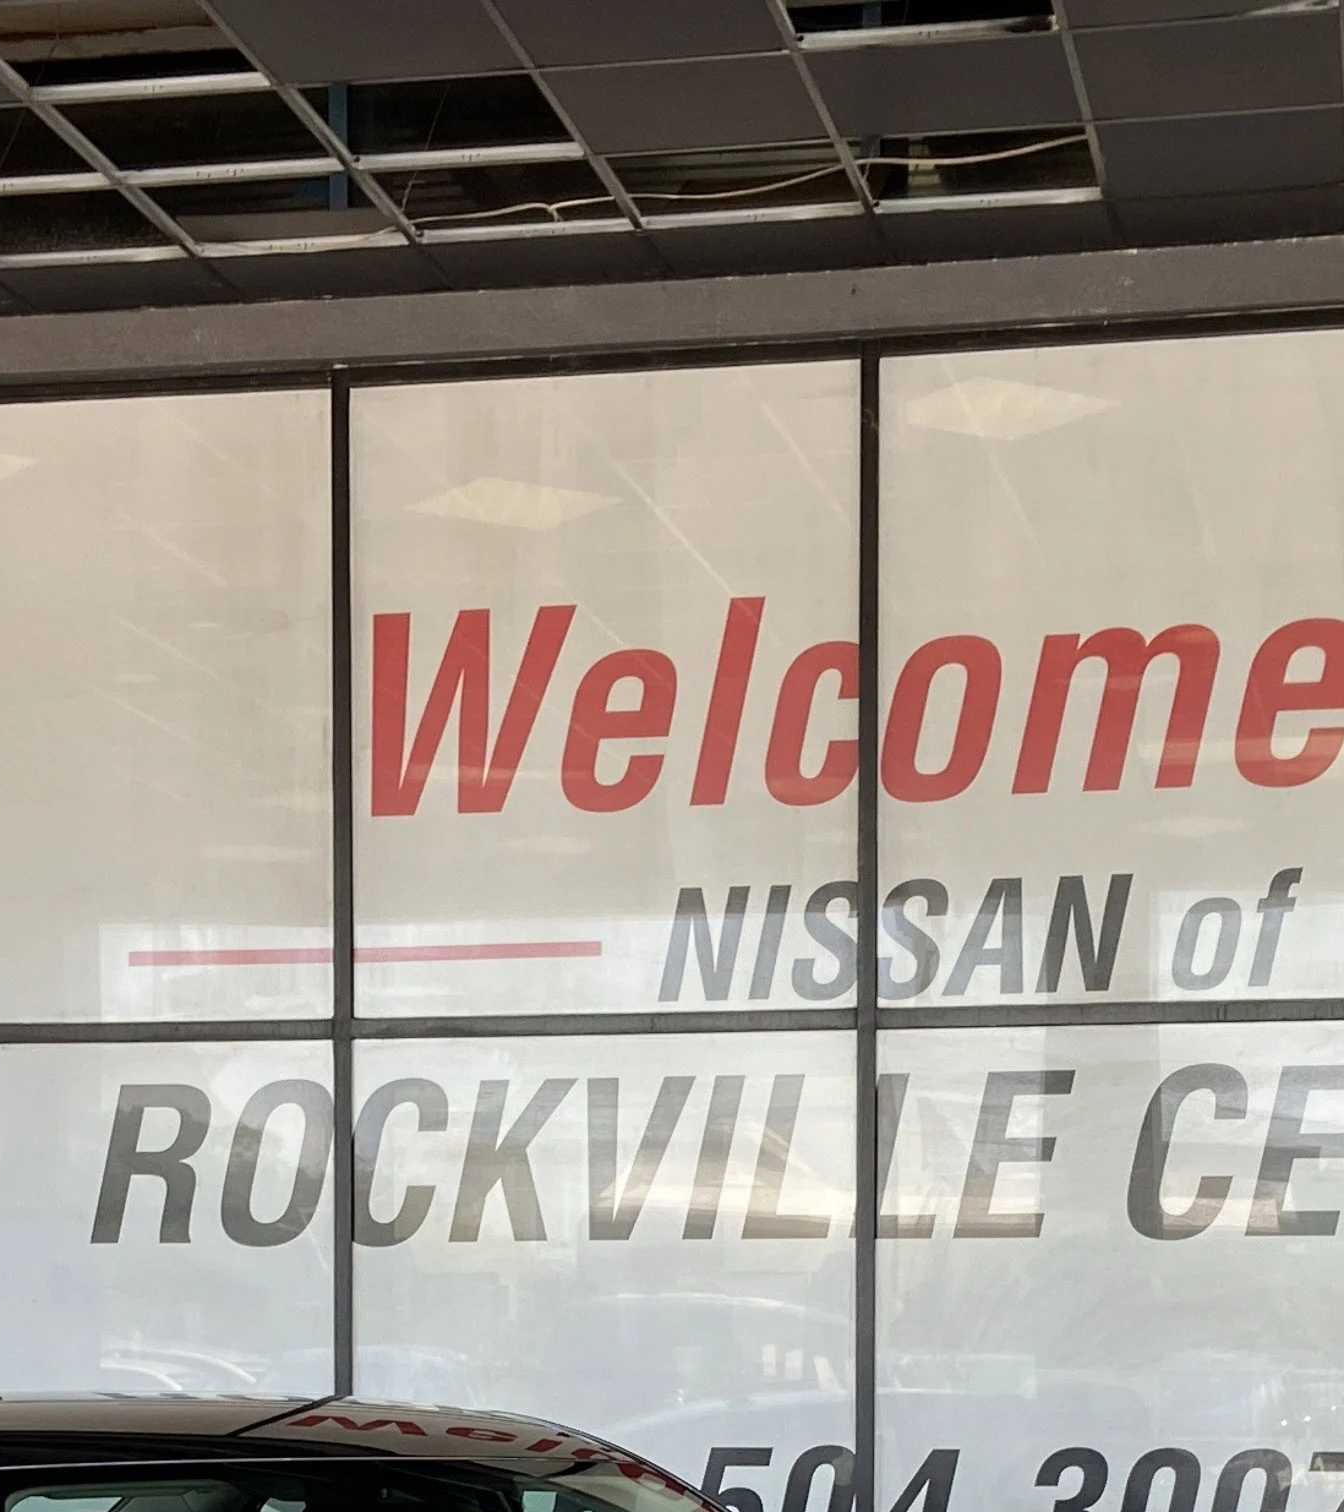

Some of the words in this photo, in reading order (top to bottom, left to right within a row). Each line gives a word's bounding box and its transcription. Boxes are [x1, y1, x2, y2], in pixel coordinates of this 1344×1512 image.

[659, 873, 1133, 1003] NISSAN
[1170, 867, 1303, 990] of
[89, 1068, 1075, 1246] ROCKVILLE
